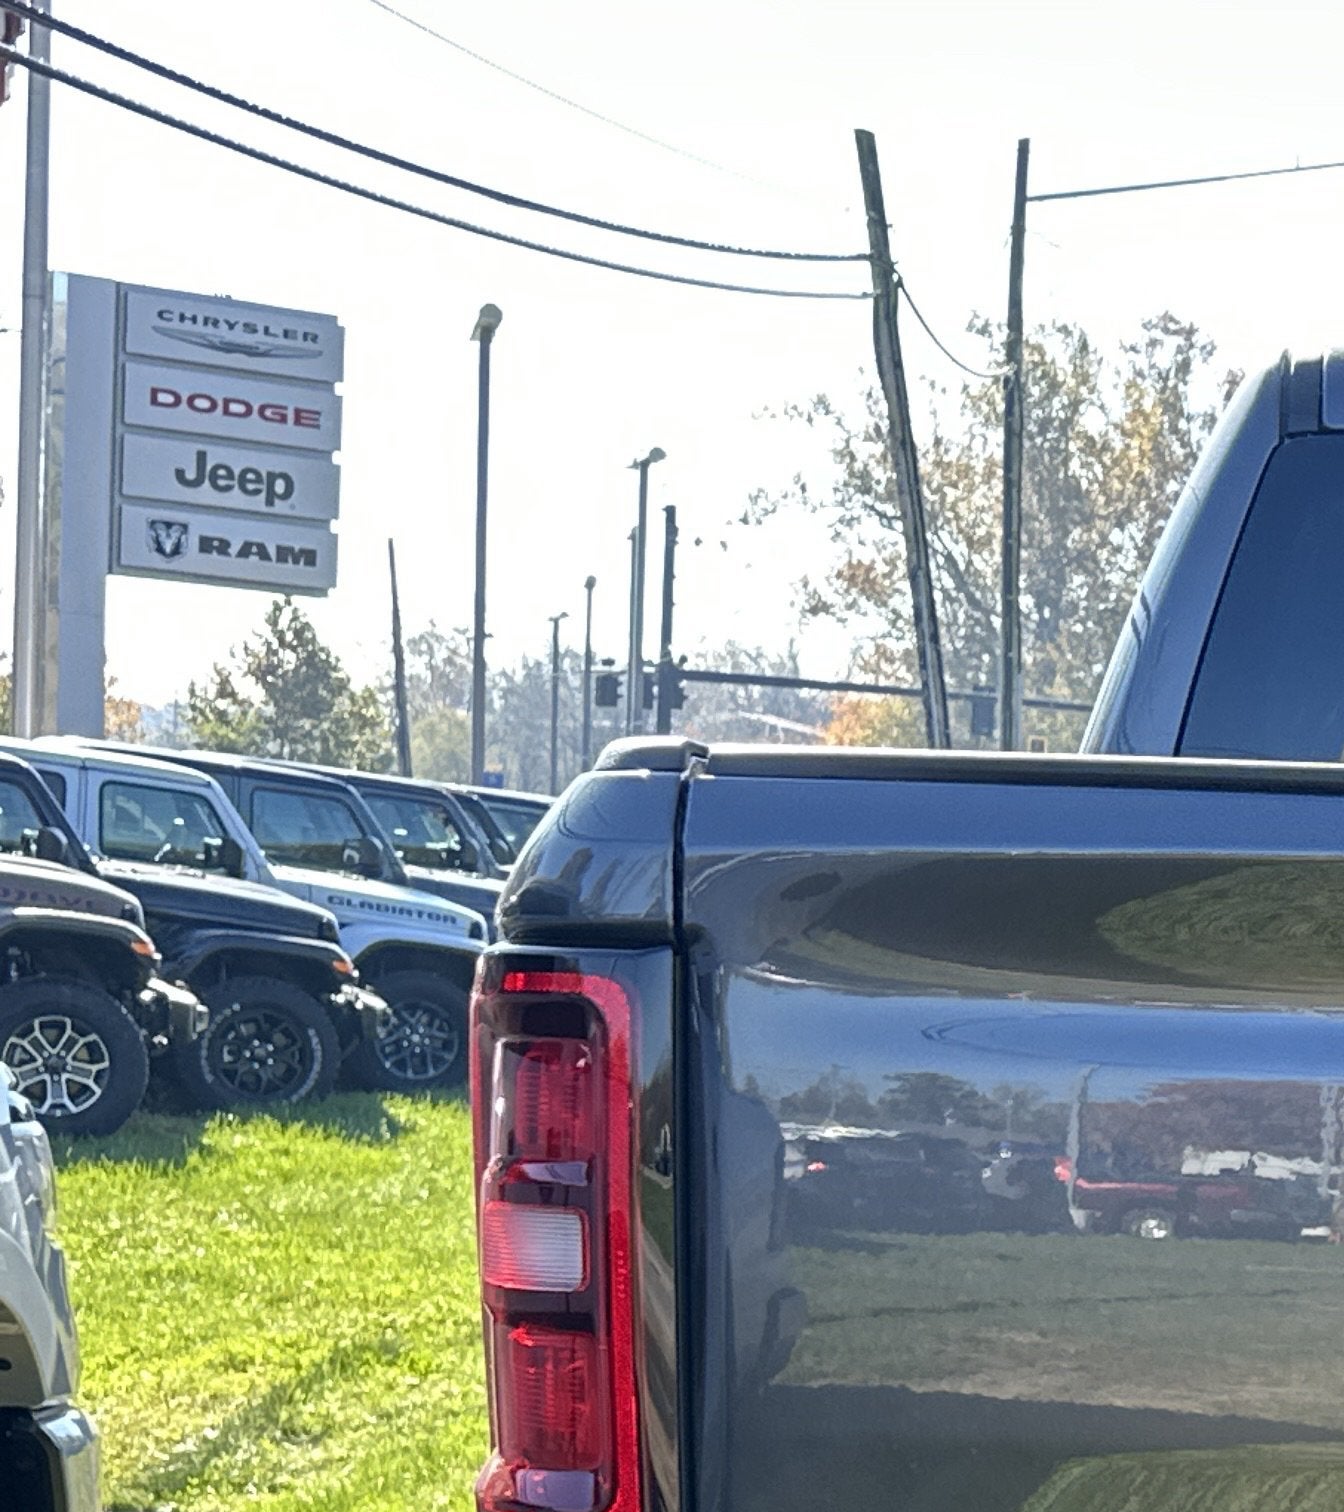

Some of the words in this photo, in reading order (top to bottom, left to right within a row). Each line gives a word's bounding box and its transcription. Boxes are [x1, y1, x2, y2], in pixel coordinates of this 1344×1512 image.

[157, 309, 319, 343] CHRYSLER
[150, 386, 321, 430] DODGE
[174, 450, 295, 507] Jeep
[198, 534, 317, 568] RAM
[327, 895, 457, 925] GLADIATOR
